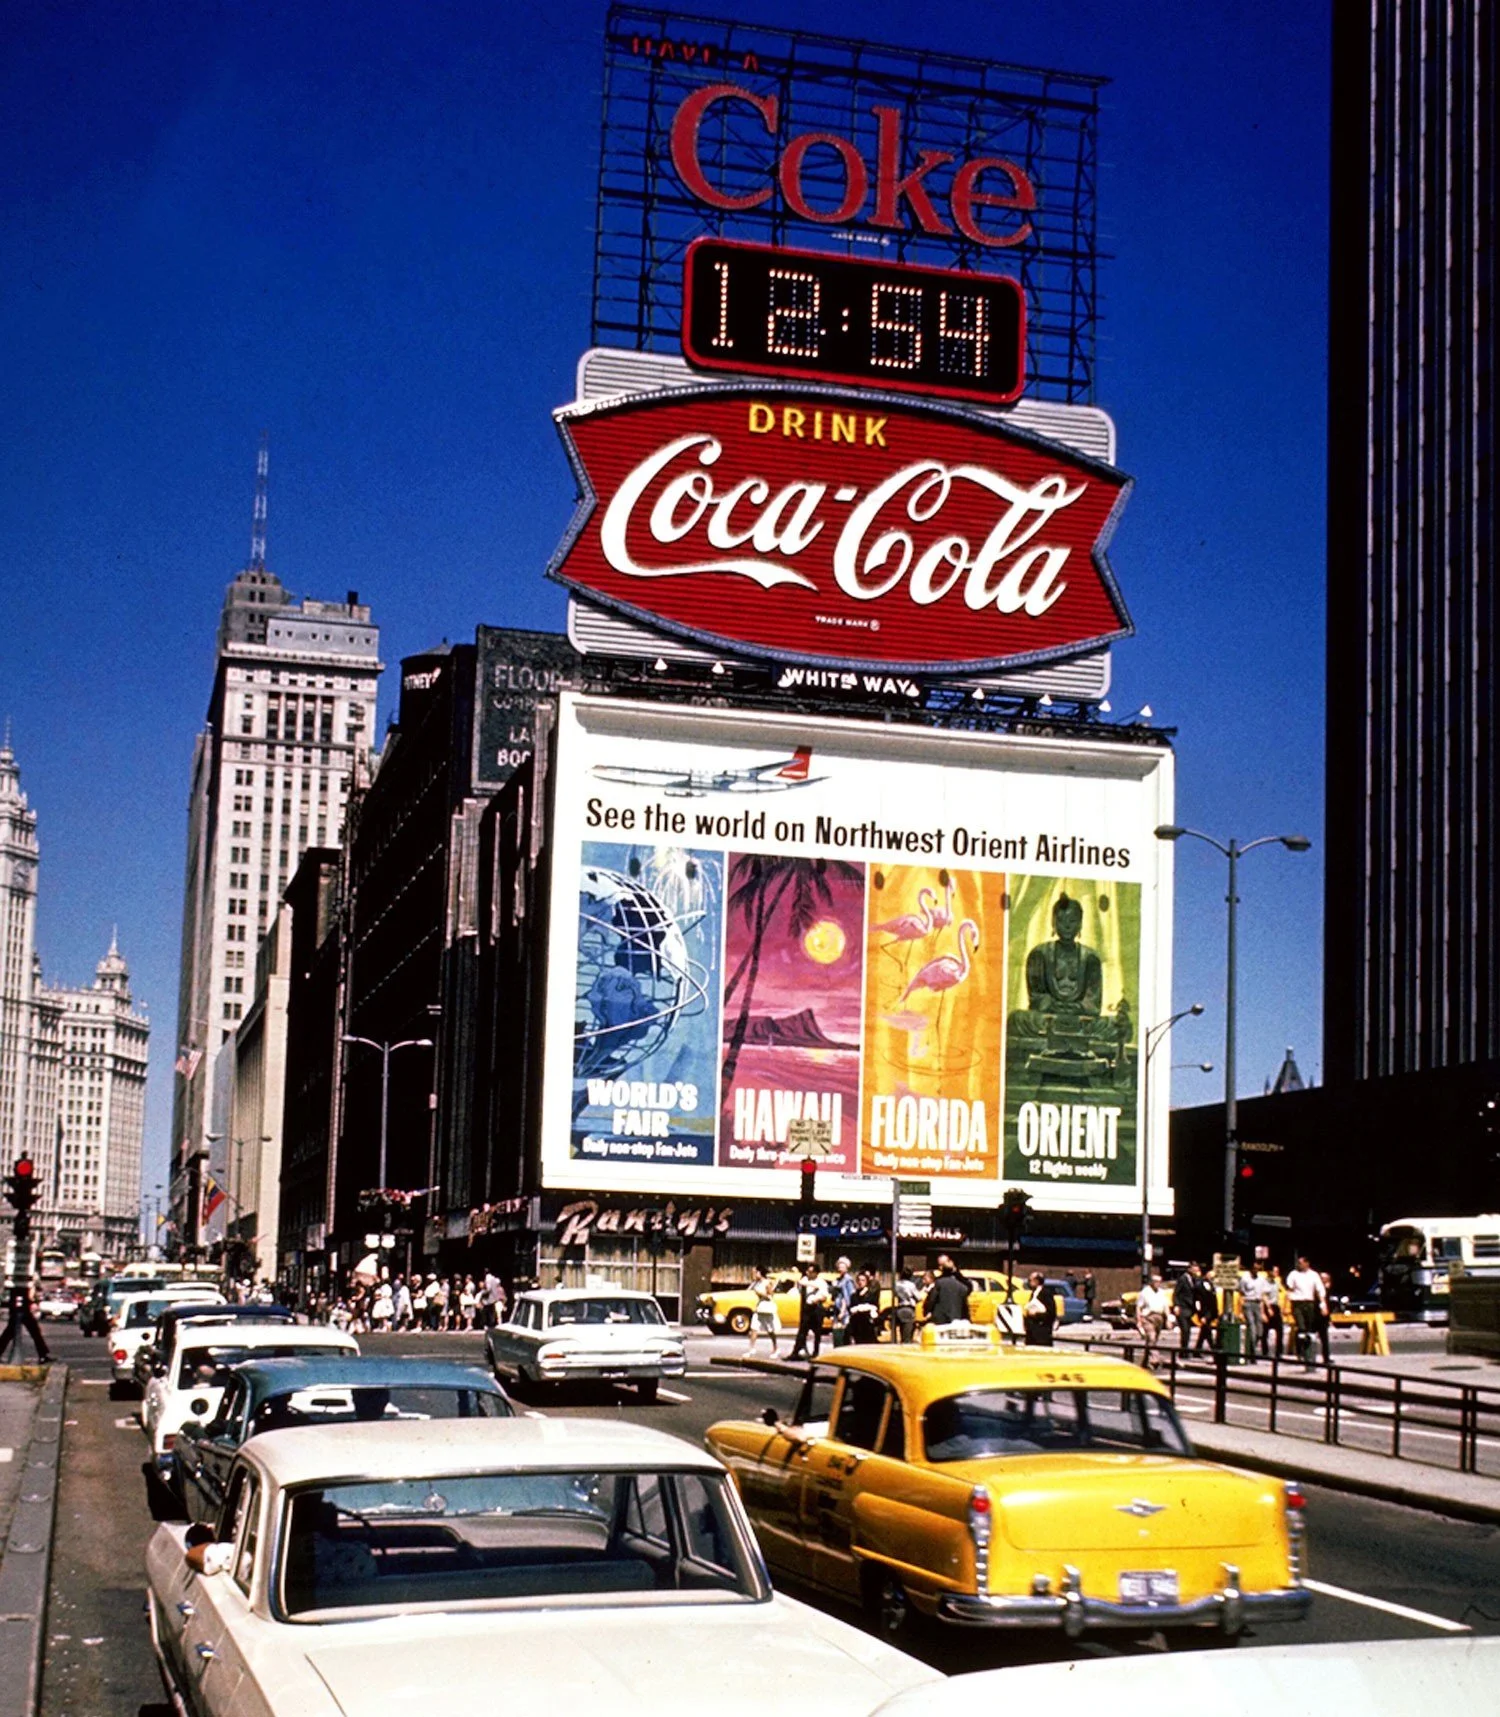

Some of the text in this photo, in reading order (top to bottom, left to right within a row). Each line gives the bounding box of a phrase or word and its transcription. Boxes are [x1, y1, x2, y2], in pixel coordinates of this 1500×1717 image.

[669, 83, 1038, 247] Coke
[713, 261, 990, 377] 12:54
[748, 402, 888, 447] DRINK
[600, 432, 1089, 617] Coca-Cola
[815, 615, 844, 625] TRADE
[845, 619, 868, 627] MARK
[862, 676, 911, 694] WAY
[586, 798, 1131, 868] See the world on Northwest Orient Airlines
[586, 1078, 698, 1112] WORLD'S
[734, 1087, 842, 1146] HAWAII
[582, 1137, 609, 1157] Daily
[612, 1109, 670, 1137] FAIR
[870, 1095, 988, 1153] FLORIDA
[1017, 1101, 1122, 1160] ORIENT
[1029, 1159, 1108, 1181] 12 flights weekly
